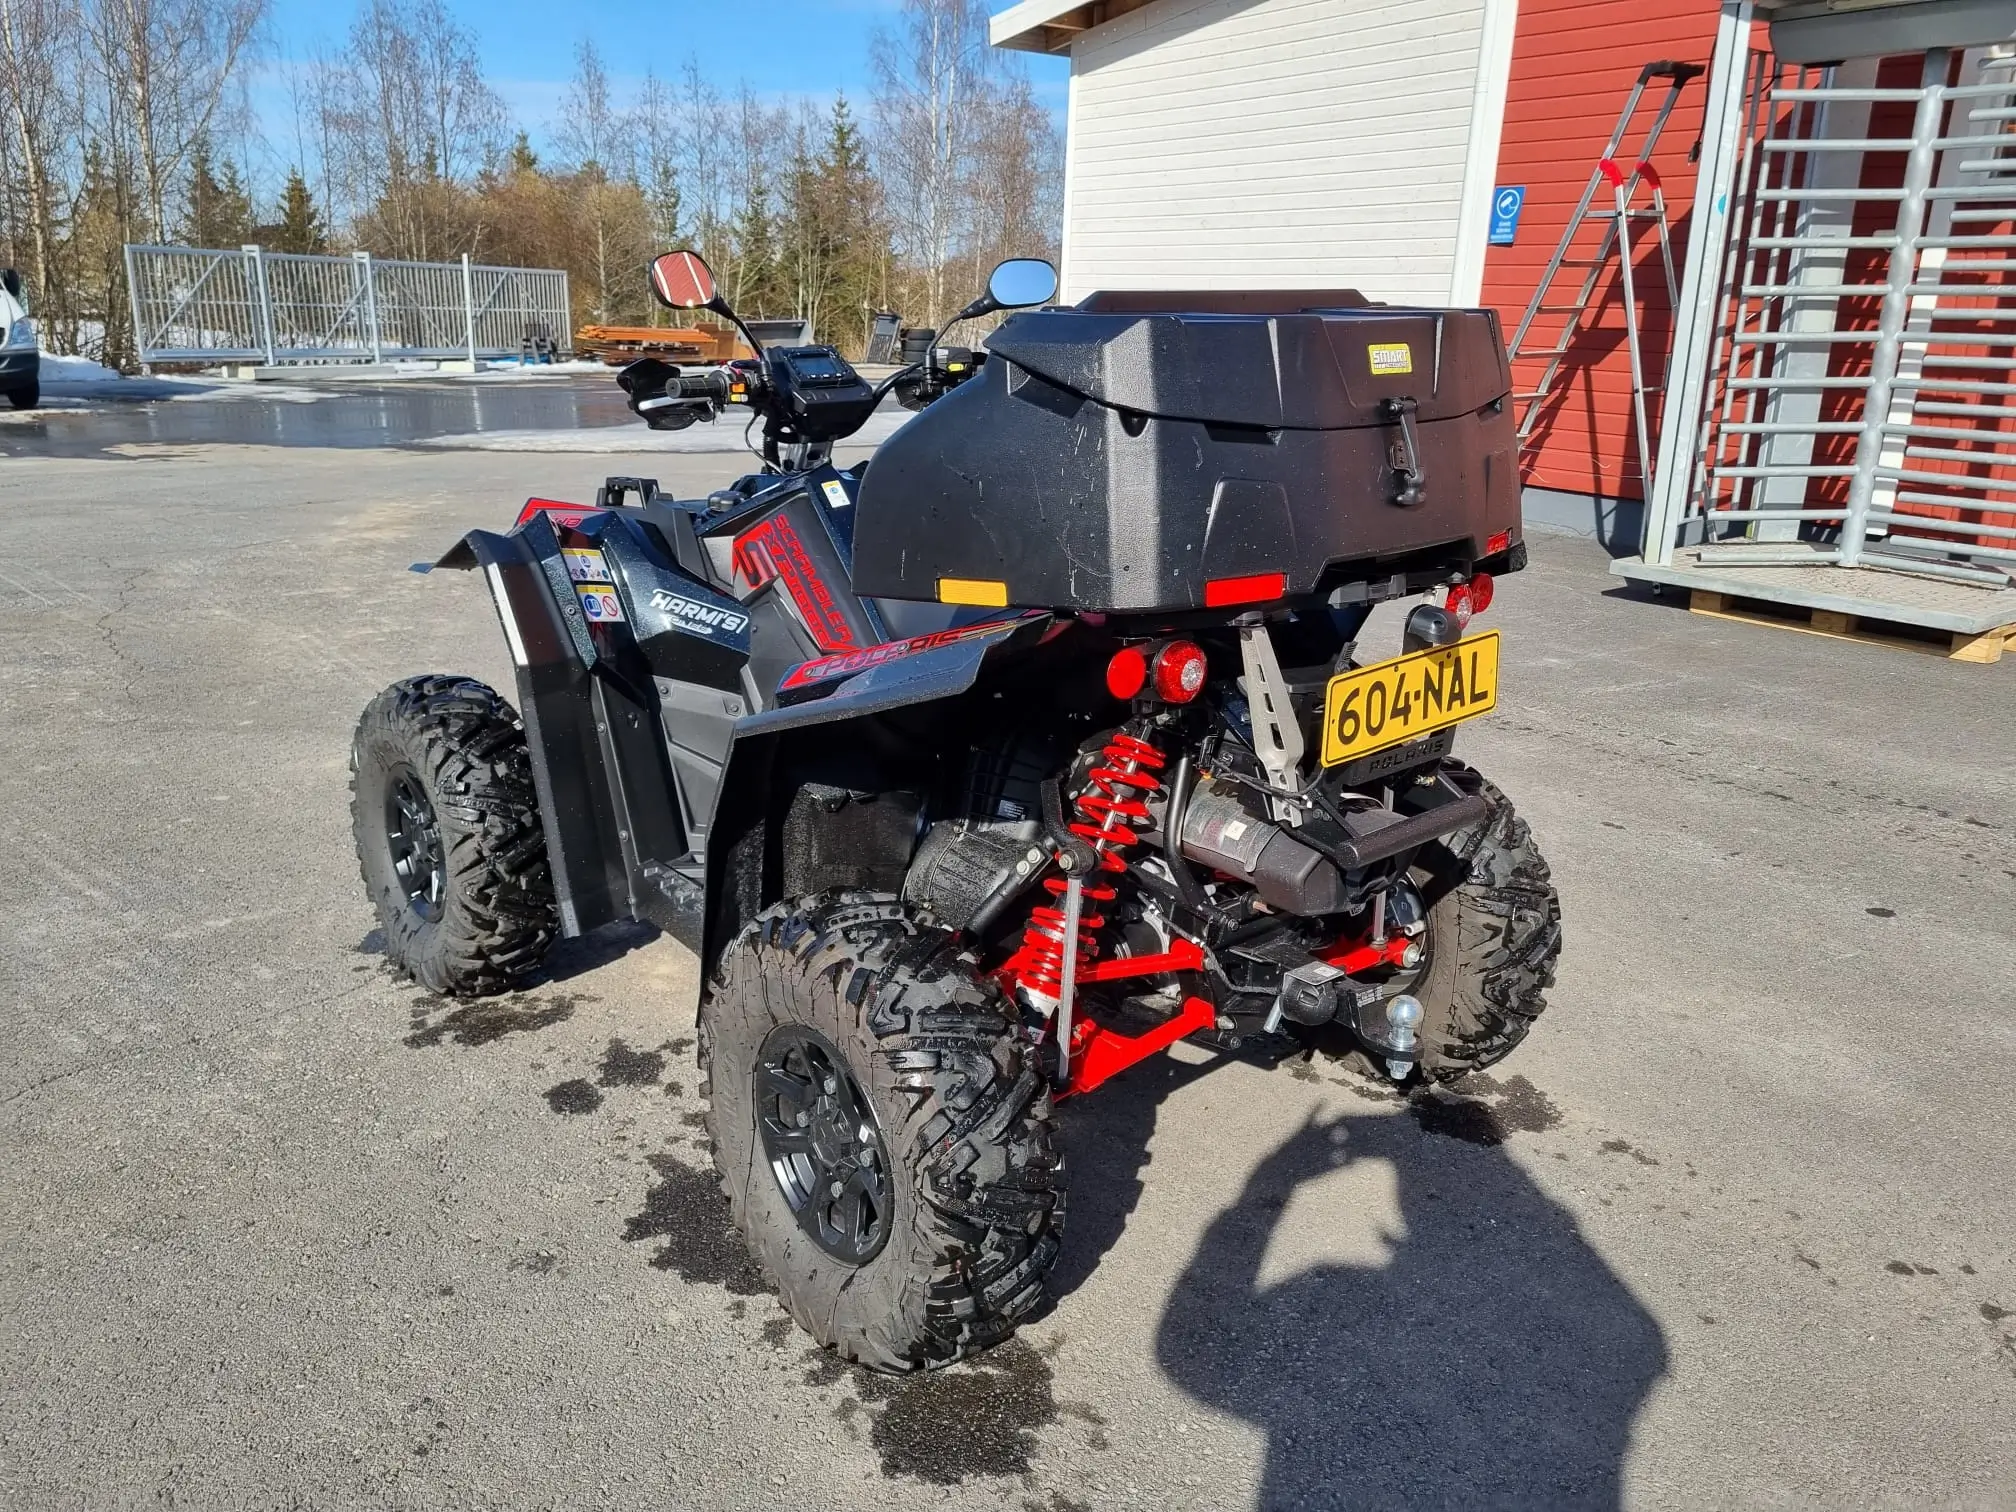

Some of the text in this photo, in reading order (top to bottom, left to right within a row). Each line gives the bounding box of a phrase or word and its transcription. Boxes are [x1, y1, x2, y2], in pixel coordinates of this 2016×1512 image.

[1373, 350, 1408, 363] SMART
[774, 514, 854, 643] SCRAMBLER
[649, 593, 741, 631] HARMI'S
[1337, 651, 1488, 745] 604-NAL
[1369, 739, 1444, 773] POLARIS
